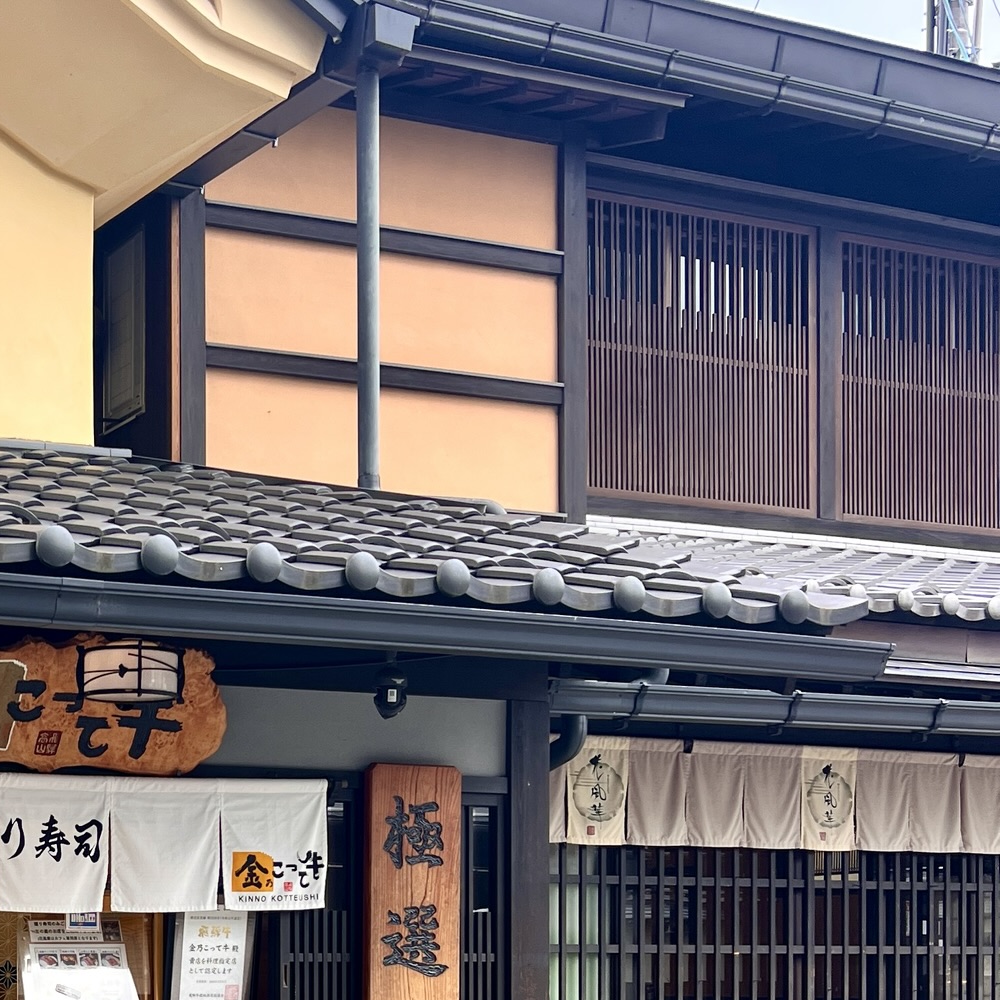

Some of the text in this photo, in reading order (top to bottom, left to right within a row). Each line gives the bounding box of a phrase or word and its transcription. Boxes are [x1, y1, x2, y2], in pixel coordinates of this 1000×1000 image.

[238, 893, 319, 903] KINNO KOTTEUSHI
[198, 925, 231, 938] 飛騨牛
[189, 943, 230, 953] 金乃こって牛
